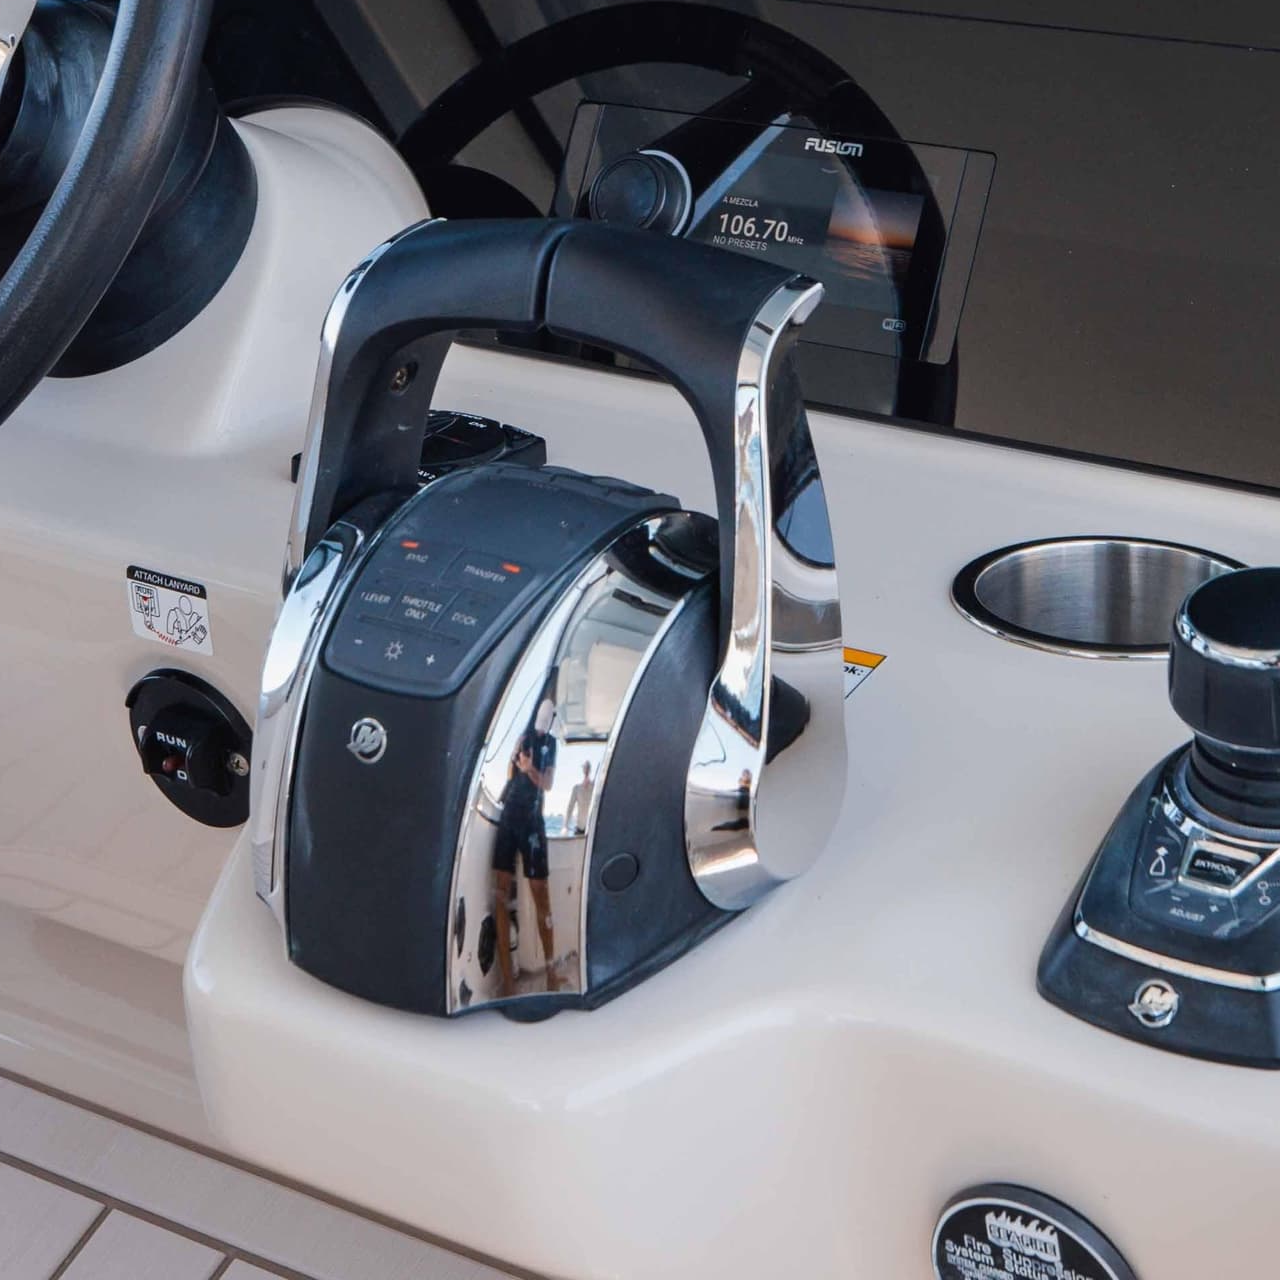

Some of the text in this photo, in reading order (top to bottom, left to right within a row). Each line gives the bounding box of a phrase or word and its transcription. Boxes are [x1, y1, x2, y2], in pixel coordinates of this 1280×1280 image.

[804, 137, 864, 158] FUSION
[729, 197, 760, 209] MEZCLA
[719, 213, 789, 243] 106.70
[713, 235, 769, 252] NO PRESETS
[134, 570, 164, 586] ATTACH
[164, 577, 201, 596] LANYARD
[464, 565, 506, 583] TRANSFER
[365, 592, 391, 604] LEVER
[401, 595, 443, 612] THROTTLE
[404, 608, 428, 621] ONLY
[156, 731, 187, 749] RUN
[1194, 859, 1237, 876] SKYHOOK
[944, 1239, 995, 1267] System
[963, 1233, 993, 1257] Fire
